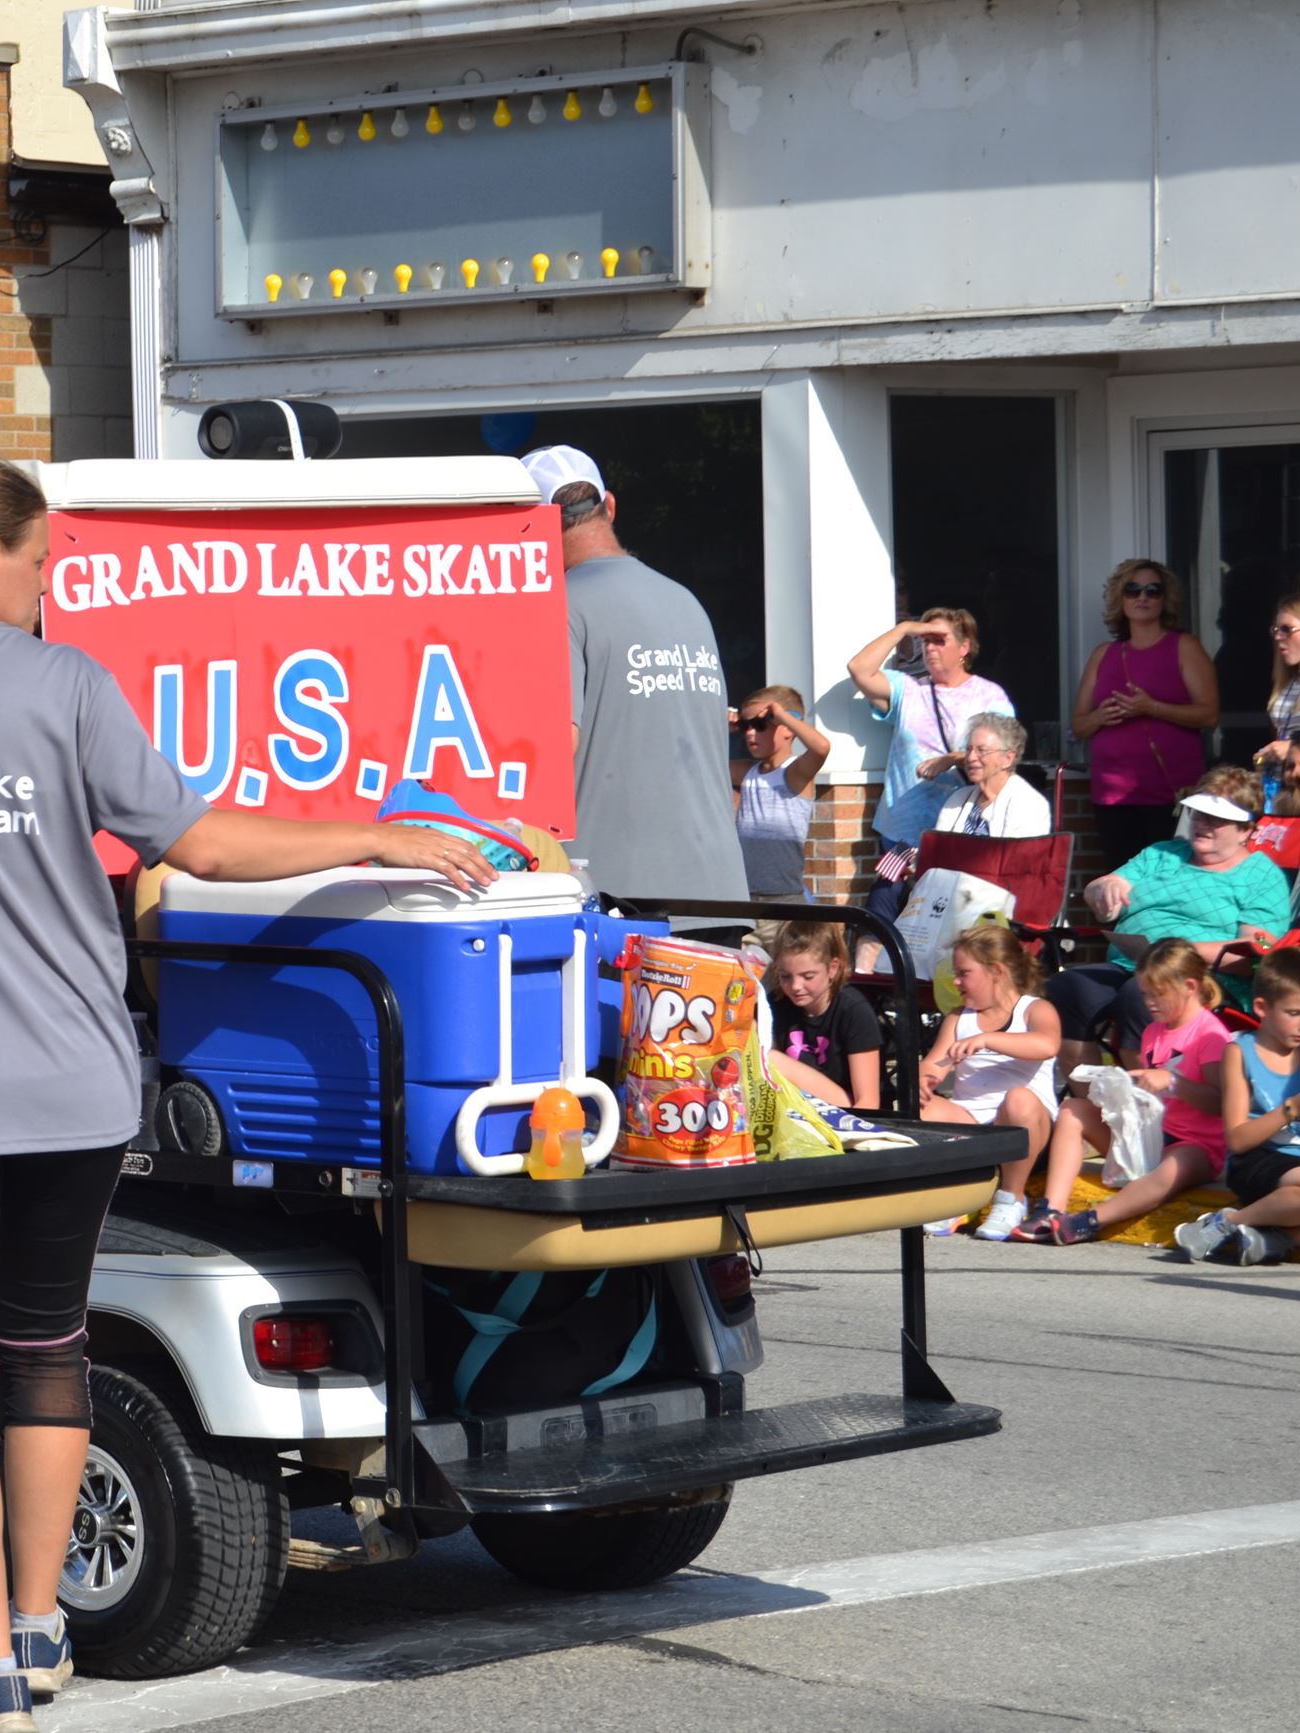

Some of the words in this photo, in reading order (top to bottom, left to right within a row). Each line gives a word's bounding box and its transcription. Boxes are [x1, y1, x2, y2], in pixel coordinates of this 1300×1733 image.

[51, 541, 248, 612] GRAND
[256, 543, 394, 597] LAKE
[402, 541, 553, 598] SKATE
[627, 643, 684, 669] Grand
[682, 643, 718, 671] Lake
[626, 669, 685, 699] Speed
[154, 644, 527, 806] U.S.A.
[655, 1099, 730, 1134] 300
[78, 1511, 91, 1541] SS
